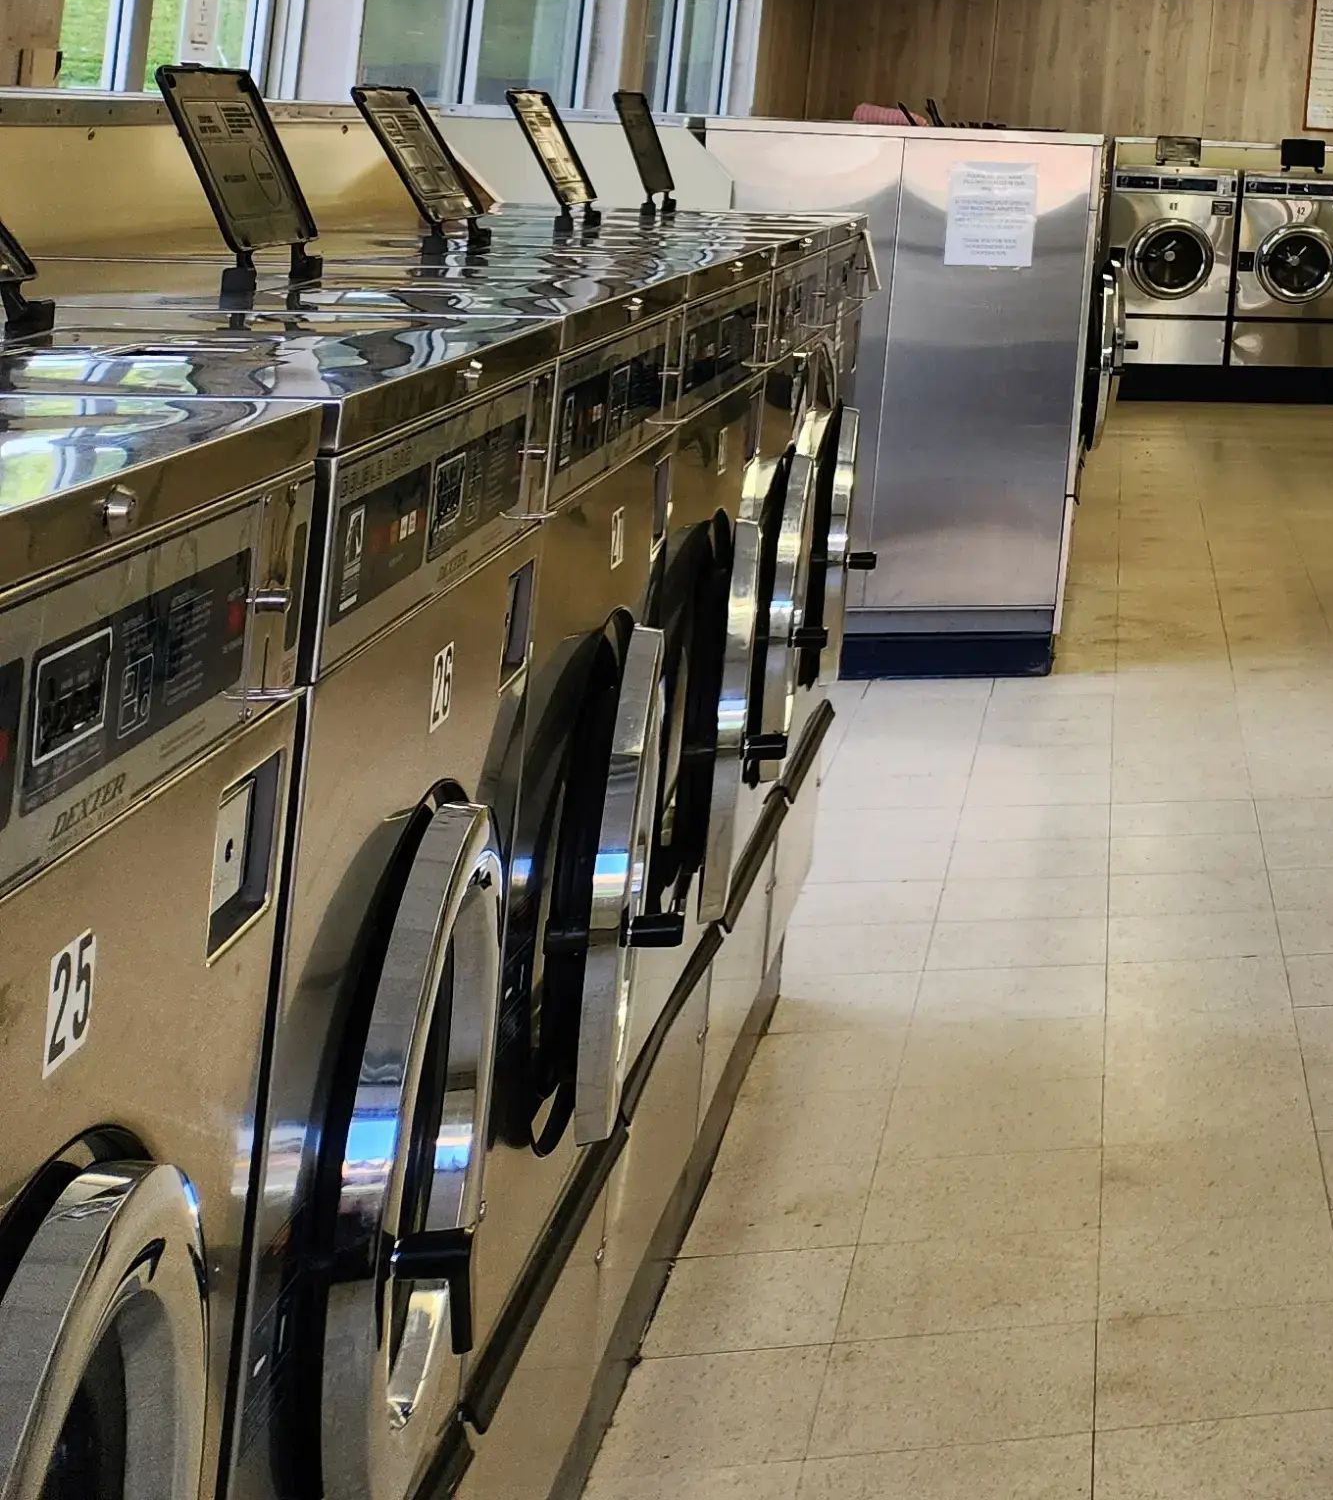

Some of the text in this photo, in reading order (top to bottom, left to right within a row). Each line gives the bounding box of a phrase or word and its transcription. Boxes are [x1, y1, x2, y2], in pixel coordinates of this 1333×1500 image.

[1297, 206, 1305, 216] 42
[433, 647, 453, 725] 26
[50, 772, 127, 842] DEXTER
[48, 933, 93, 1064] 25
